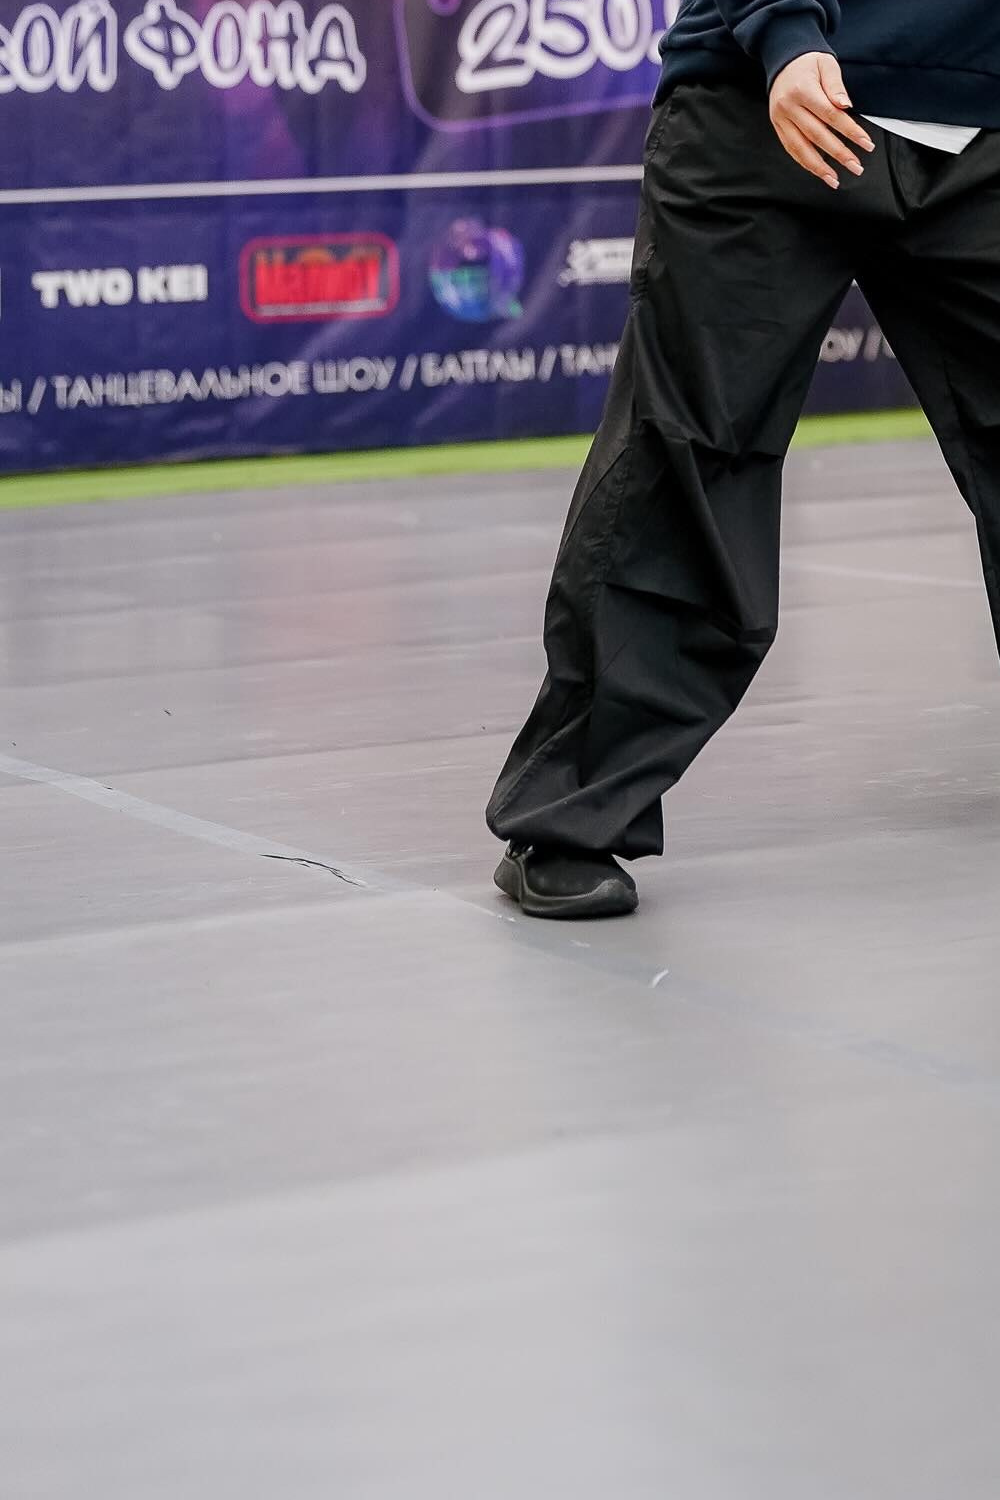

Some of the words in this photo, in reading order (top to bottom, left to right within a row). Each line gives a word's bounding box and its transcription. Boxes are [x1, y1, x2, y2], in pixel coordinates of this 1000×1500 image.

[32, 268, 133, 308] TWO
[52, 360, 309, 410] ТАНЦЕВАЛЬНОЕ
[312, 356, 397, 394] ШОУ
